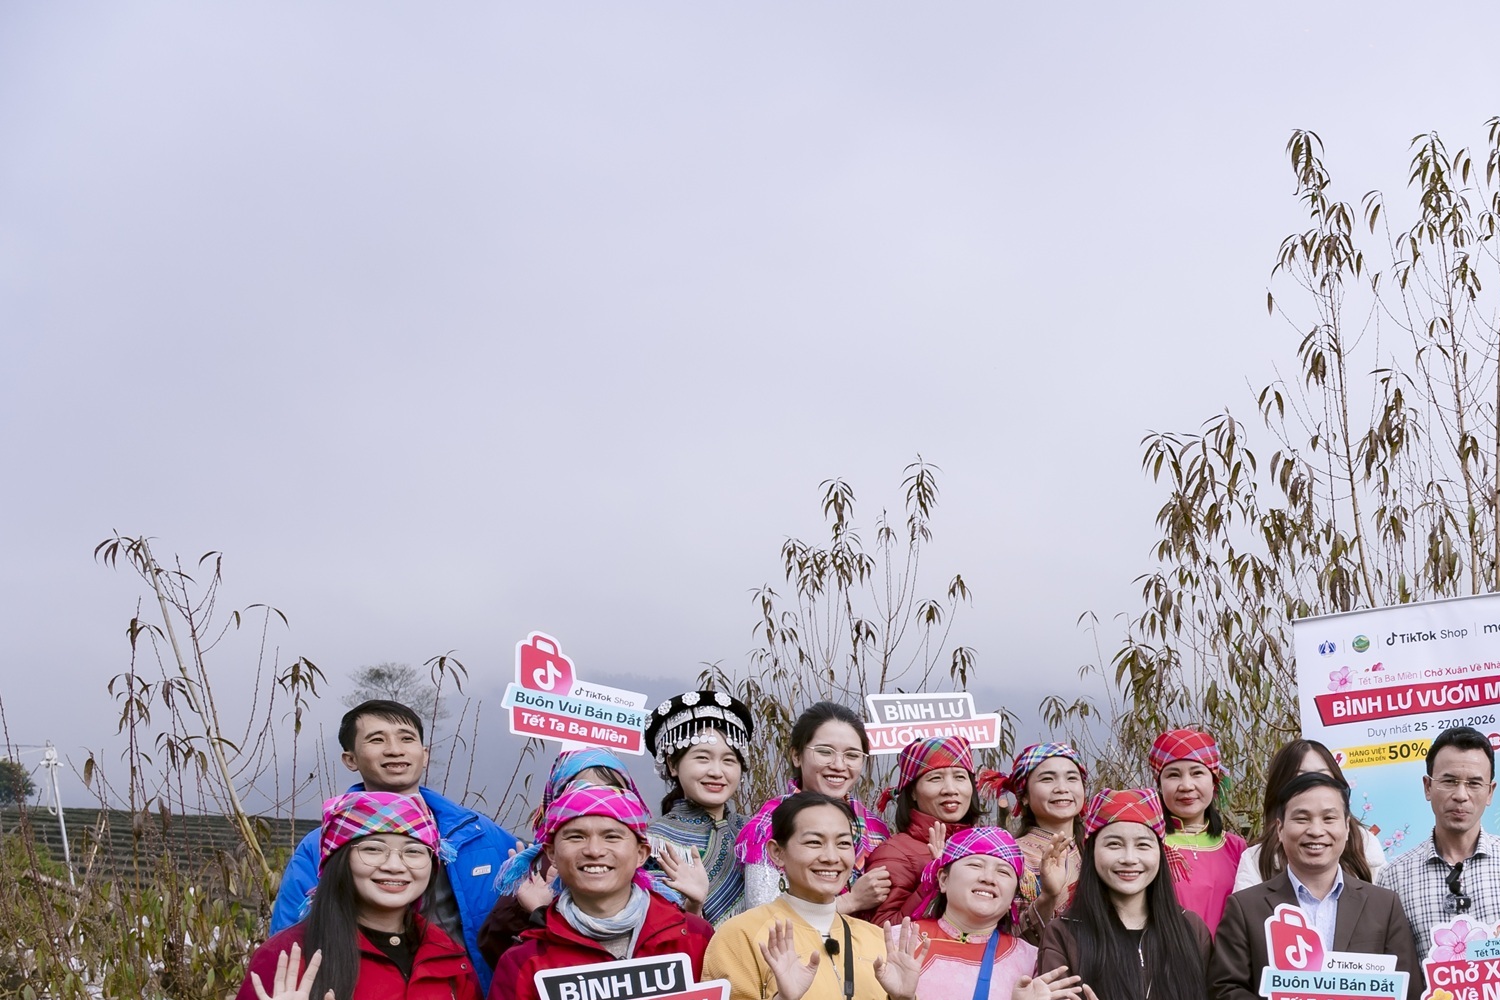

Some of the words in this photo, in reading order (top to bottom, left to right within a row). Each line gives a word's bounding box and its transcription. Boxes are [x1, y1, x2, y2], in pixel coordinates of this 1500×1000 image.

[1399, 631, 1437, 644] TikTok
[1440, 628, 1468, 639] Shop
[1373, 675, 1383, 684] Ta
[1384, 674, 1395, 683] Ba
[1397, 672, 1418, 681] Miền
[1424, 668, 1443, 678] Chở
[1445, 665, 1468, 676] Xuân
[1469, 662, 1482, 672] Về
[515, 691, 554, 709] Buôn
[559, 700, 581, 715] Vui
[584, 706, 613, 722] Bán
[616, 712, 642, 727] Đắt
[585, 690, 612, 703] TikTok
[614, 697, 635, 708] Shop
[884, 701, 935, 720] BÌNH
[939, 698, 964, 718] LƯ
[1332, 696, 1382, 718] BÌNH
[1387, 689, 1413, 711] LƯ
[1416, 683, 1480, 707] VƯƠN
[521, 712, 546, 728] Tết
[549, 717, 565, 732] Ta
[568, 723, 588, 737] Ba
[591, 727, 628, 744] Miền
[1367, 727, 1387, 738] Duy
[1389, 724, 1412, 735] nhất
[1414, 722, 1428, 731] 25
[1438, 714, 1496, 729] 27.01.2026
[1349, 749, 1370, 757] HÀNG
[1370, 747, 1387, 756] VIỆT
[1388, 742, 1428, 760] 50%
[1474, 948, 1488, 958] Tết
[1490, 947, 1500, 956] Ta
[1337, 961, 1363, 970] TikTok
[1365, 962, 1385, 971] Shop
[1433, 962, 1479, 986] Chở
[639, 962, 677, 994] LƯ
[1272, 975, 1309, 989] Buôn
[1313, 977, 1336, 990] Vui
[1339, 977, 1366, 991] Bán
[1370, 978, 1395, 993] Đắt
